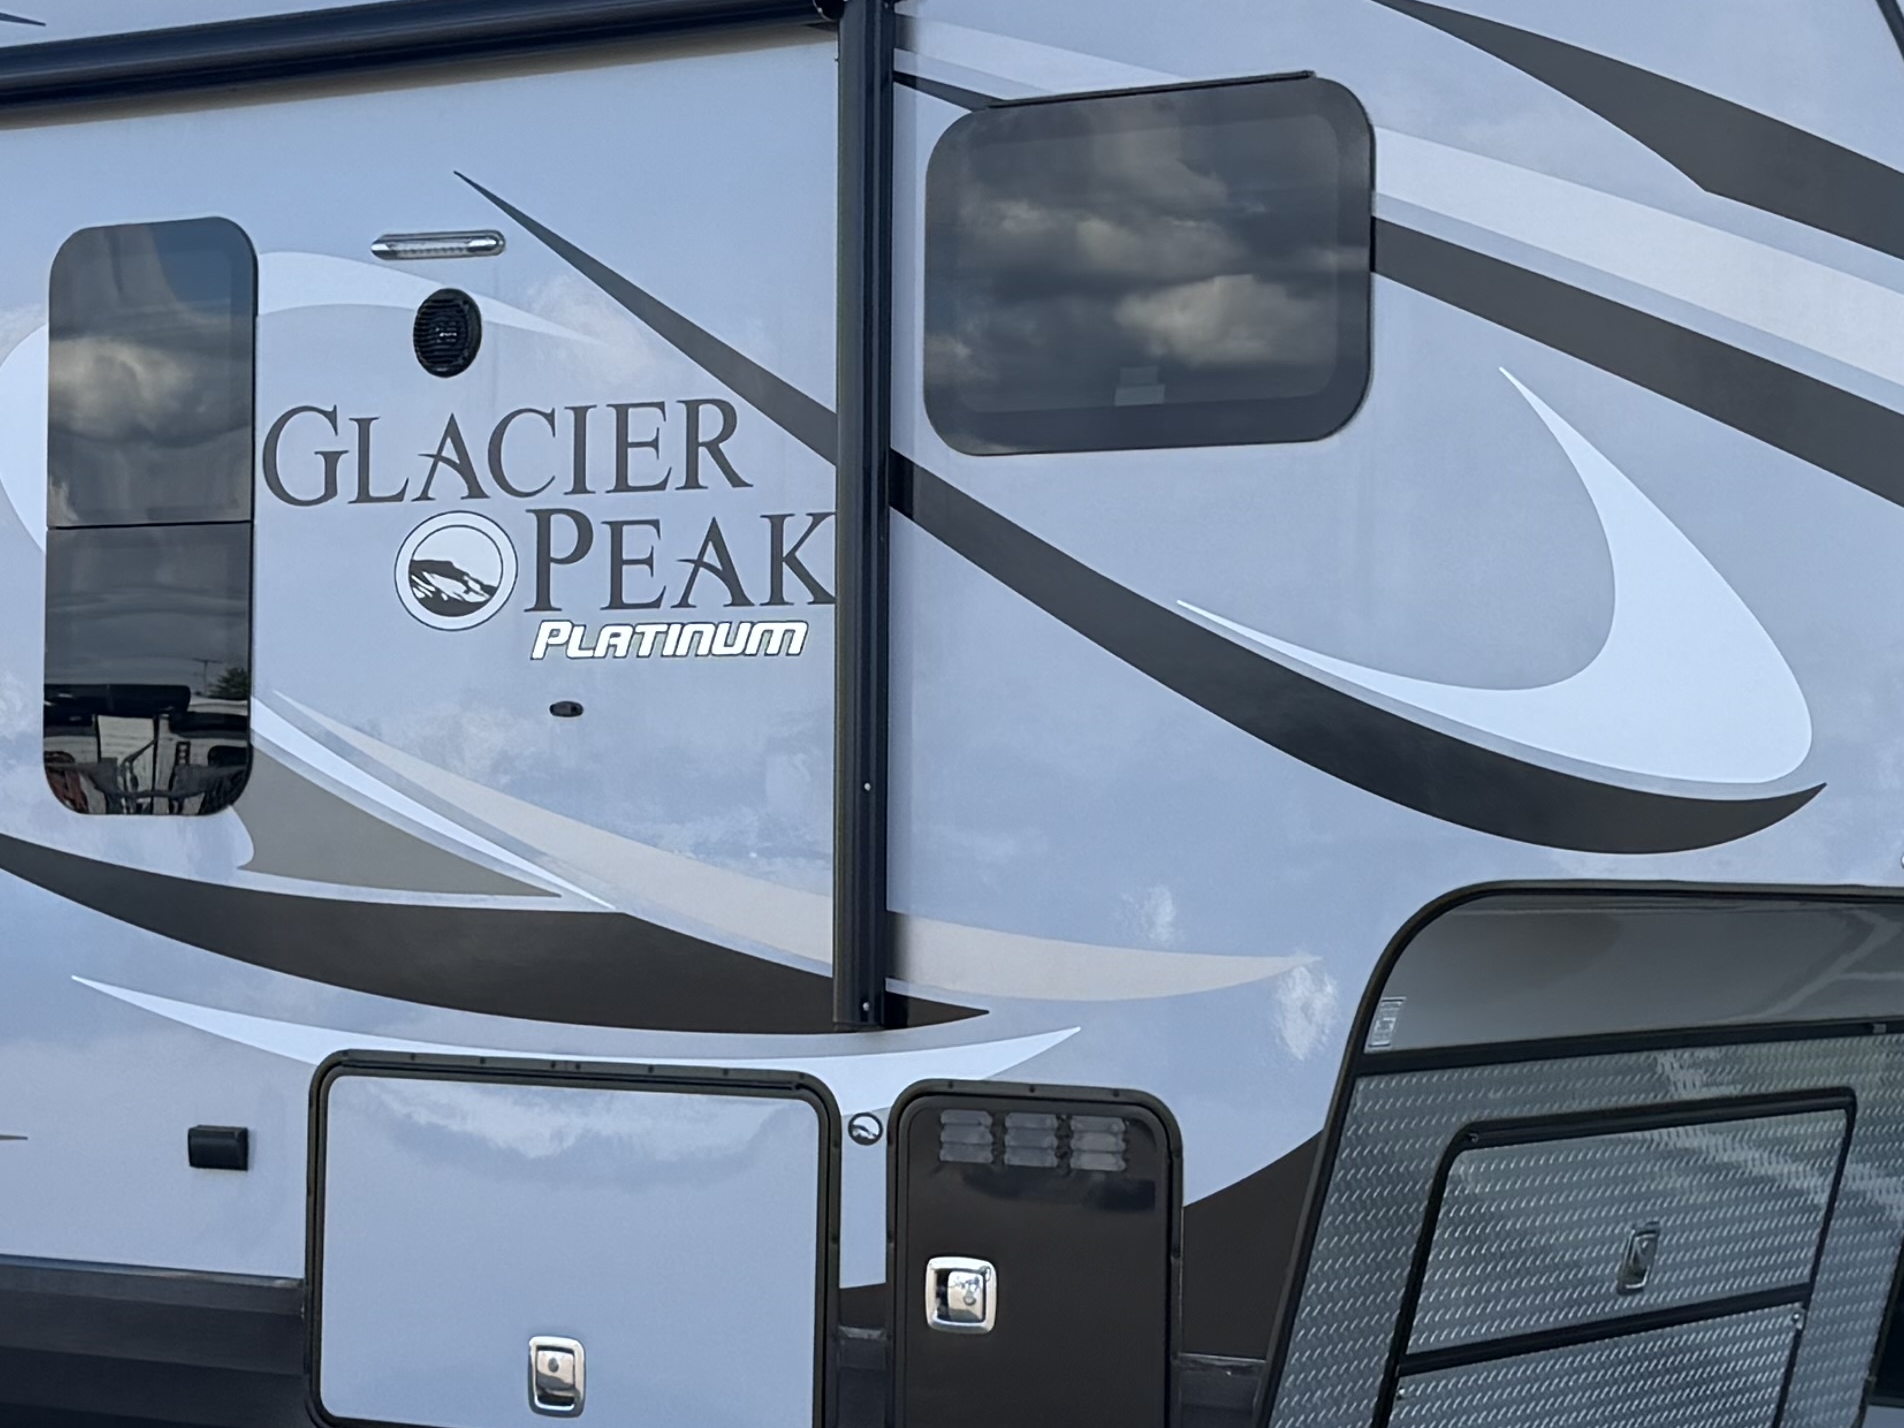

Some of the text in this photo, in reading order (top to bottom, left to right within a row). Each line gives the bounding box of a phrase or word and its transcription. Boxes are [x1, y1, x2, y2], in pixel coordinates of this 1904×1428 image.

[261, 397, 754, 507] GLACIER
[523, 507, 837, 613] PEAK
[529, 618, 809, 662] PLATINUM
